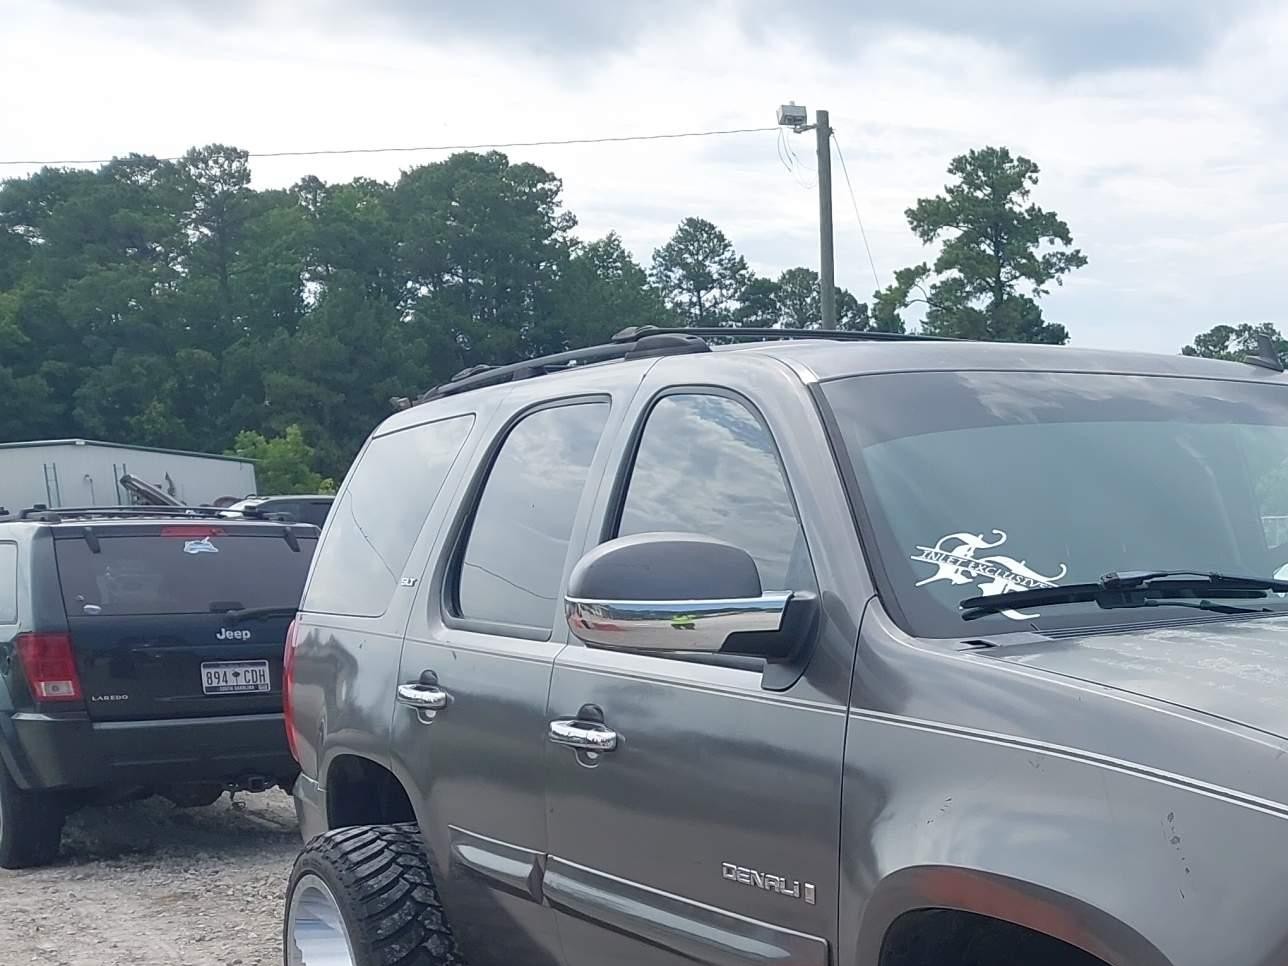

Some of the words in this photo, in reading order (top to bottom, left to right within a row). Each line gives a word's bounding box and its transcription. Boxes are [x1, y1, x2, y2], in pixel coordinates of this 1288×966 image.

[921, 550, 965, 567] INLET
[216, 628, 250, 640] Jeep
[206, 671, 228, 685] 894
[244, 669, 266, 683] CDH
[721, 862, 800, 898] DENALI
